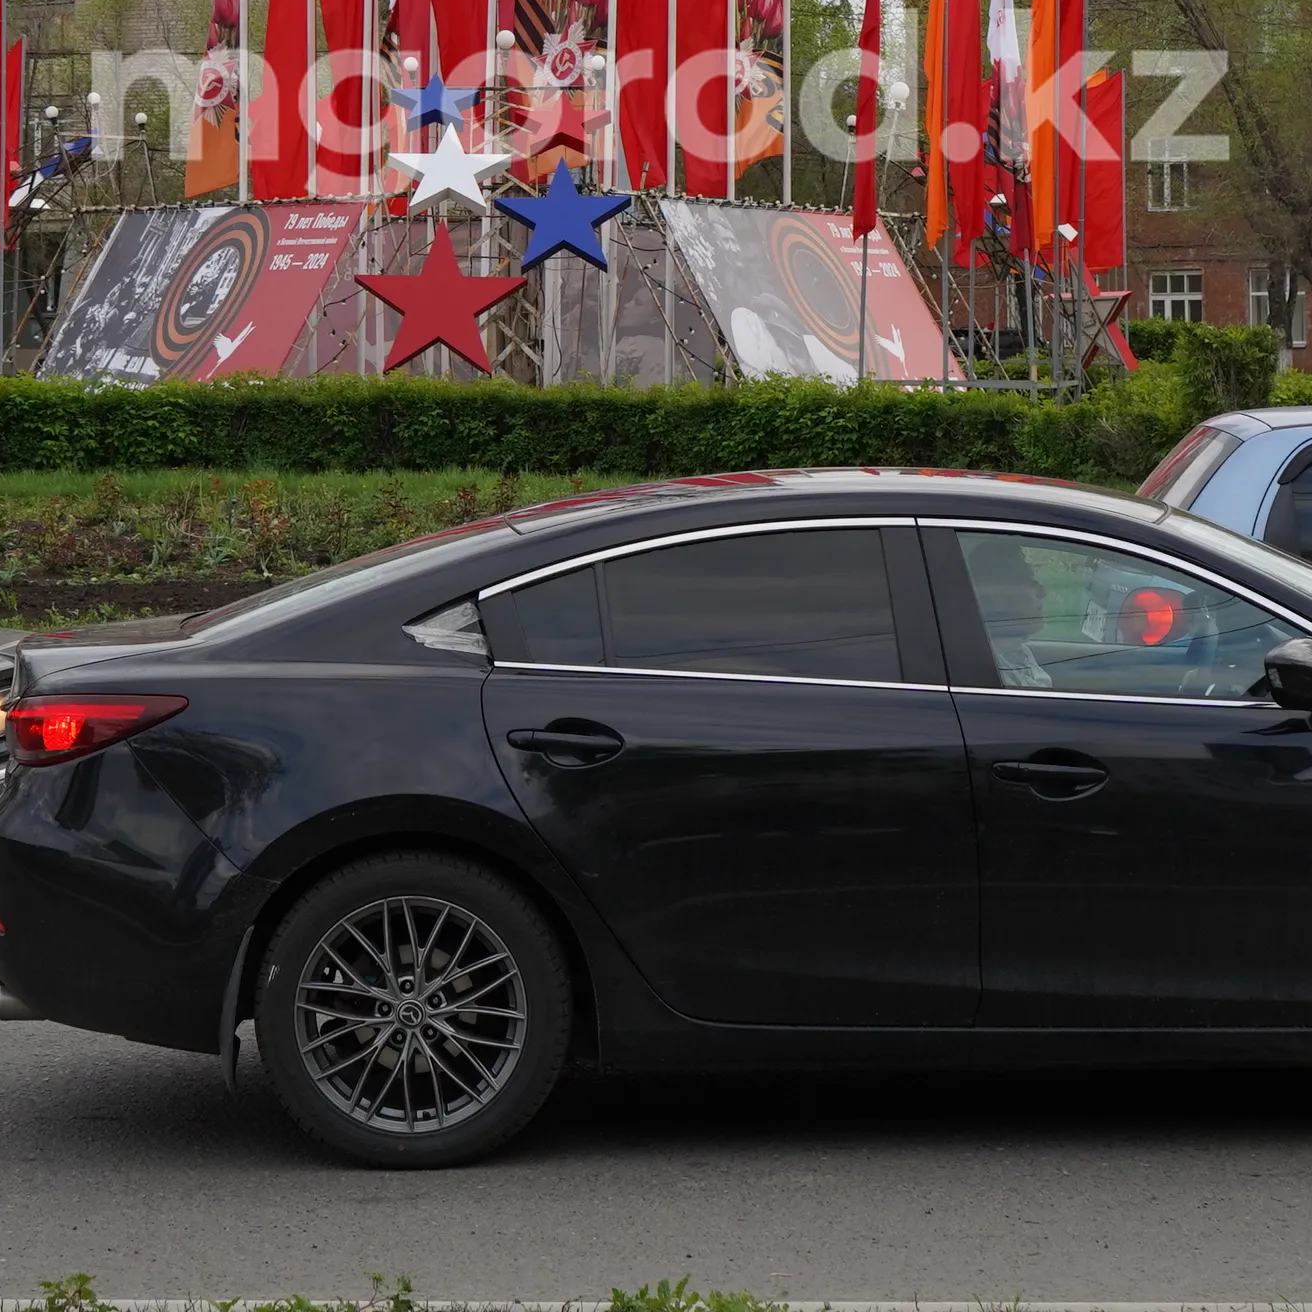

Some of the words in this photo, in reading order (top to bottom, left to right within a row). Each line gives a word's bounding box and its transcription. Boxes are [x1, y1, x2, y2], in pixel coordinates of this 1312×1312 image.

[284, 213, 299, 229] 79
[296, 217, 315, 229] лет
[312, 212, 350, 231] Победы
[269, 254, 294, 271] 1945
[302, 253, 330, 270] 2024
